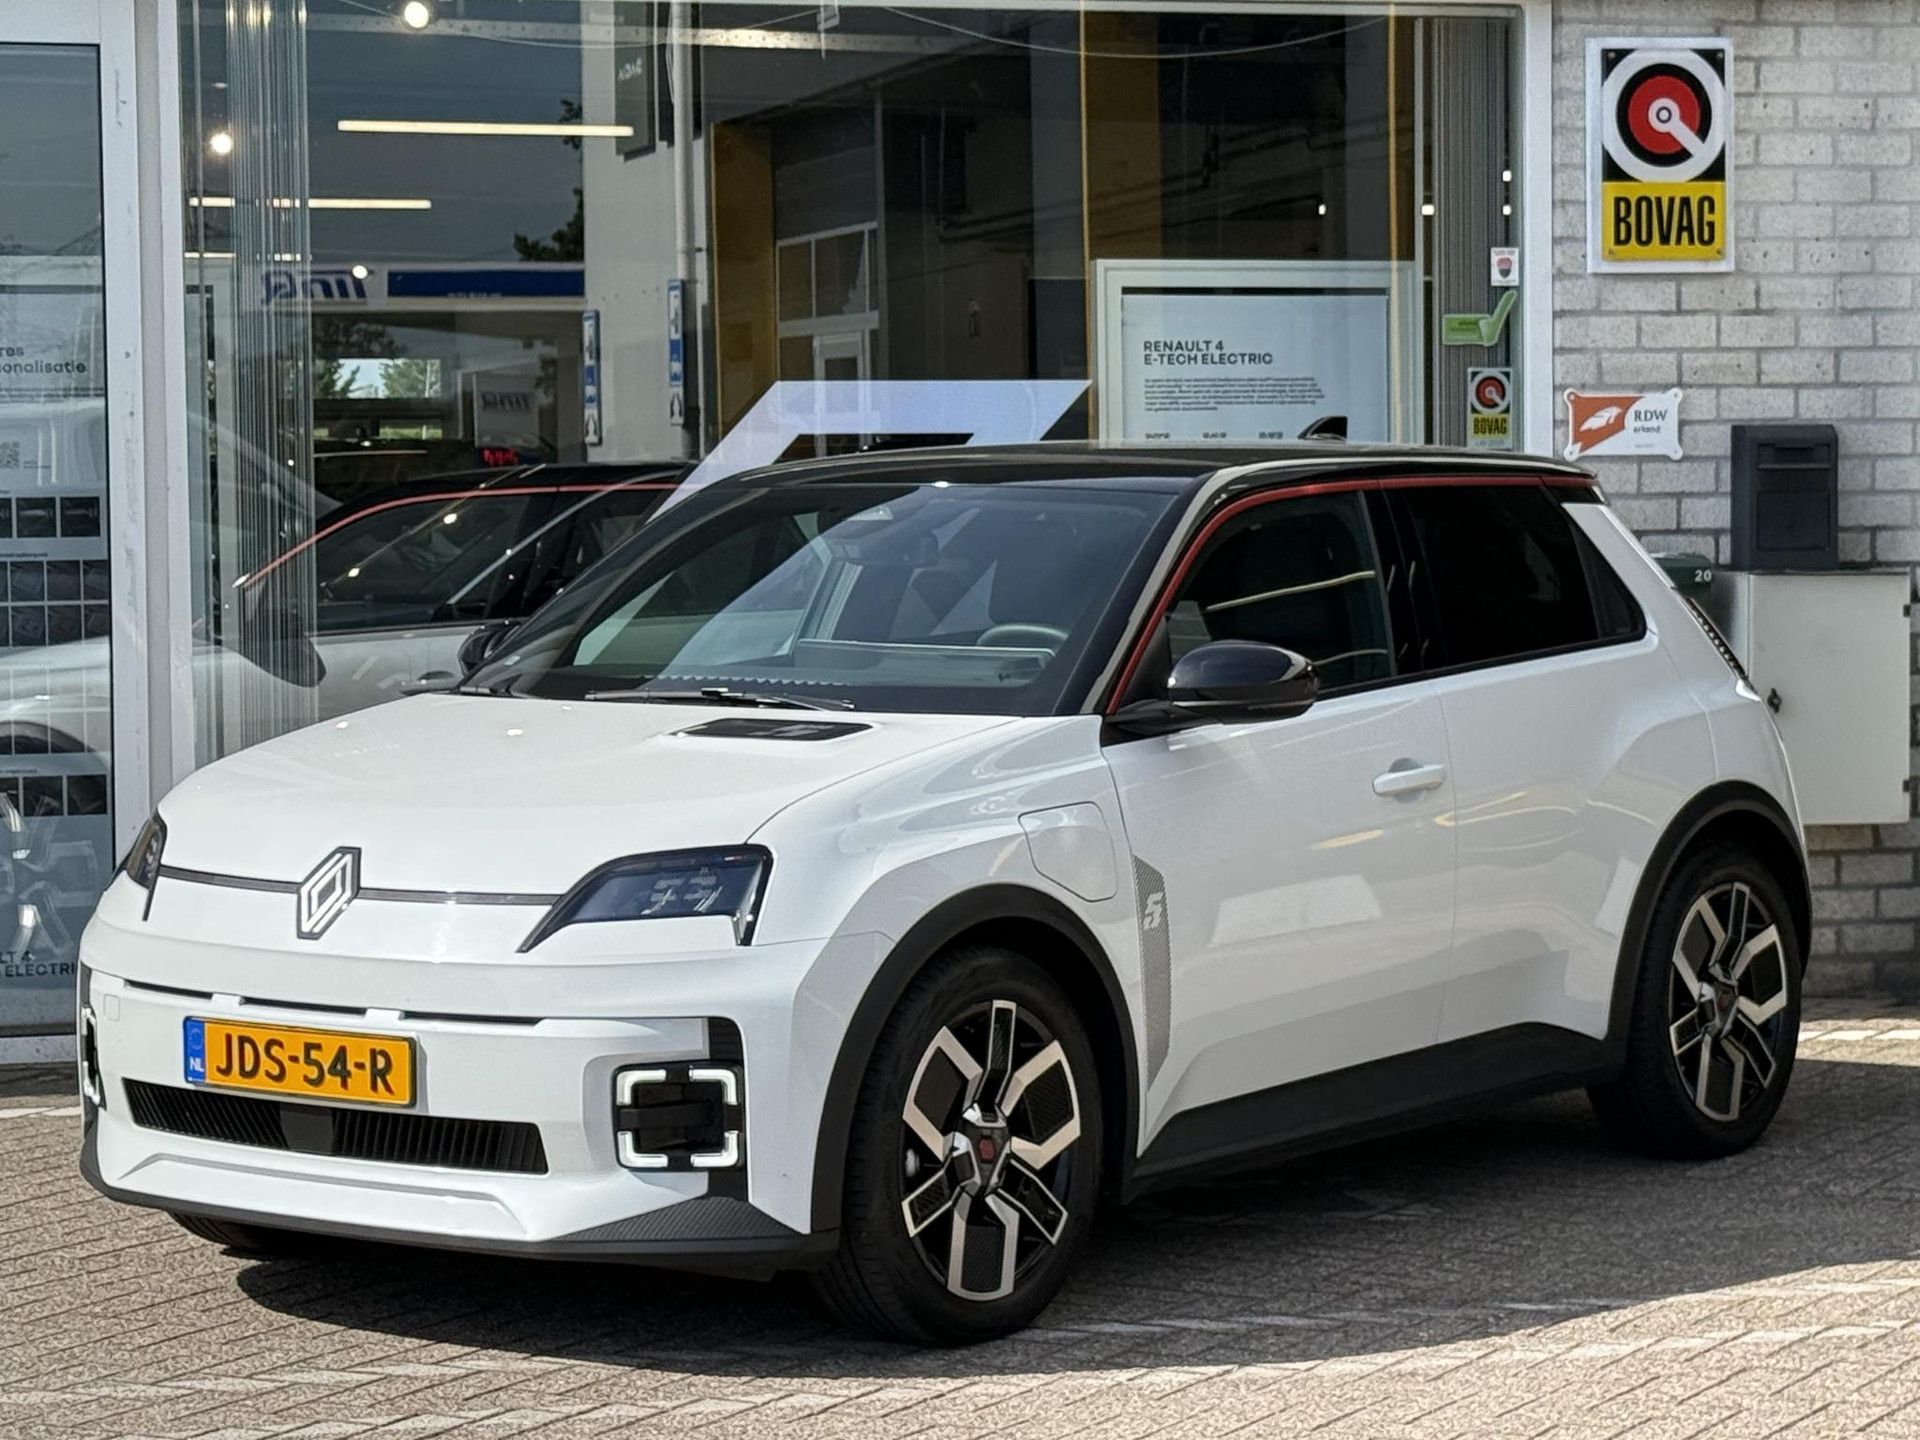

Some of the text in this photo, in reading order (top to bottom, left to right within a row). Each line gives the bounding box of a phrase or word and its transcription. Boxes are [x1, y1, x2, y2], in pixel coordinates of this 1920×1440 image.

[1613, 195, 1716, 247] BOVAG
[1143, 340, 1224, 352] RENAULT 4
[1144, 353, 1274, 366] E-TECH ELECTRIC
[0, 360, 86, 373] onalisatie
[1634, 409, 1668, 421] RDW
[1473, 417, 1507, 435] BOVAG
[1694, 569, 1712, 582] 20
[5, 962, 78, 978] ELECTRI
[189, 1032, 396, 1095] NL JDS-54-R
